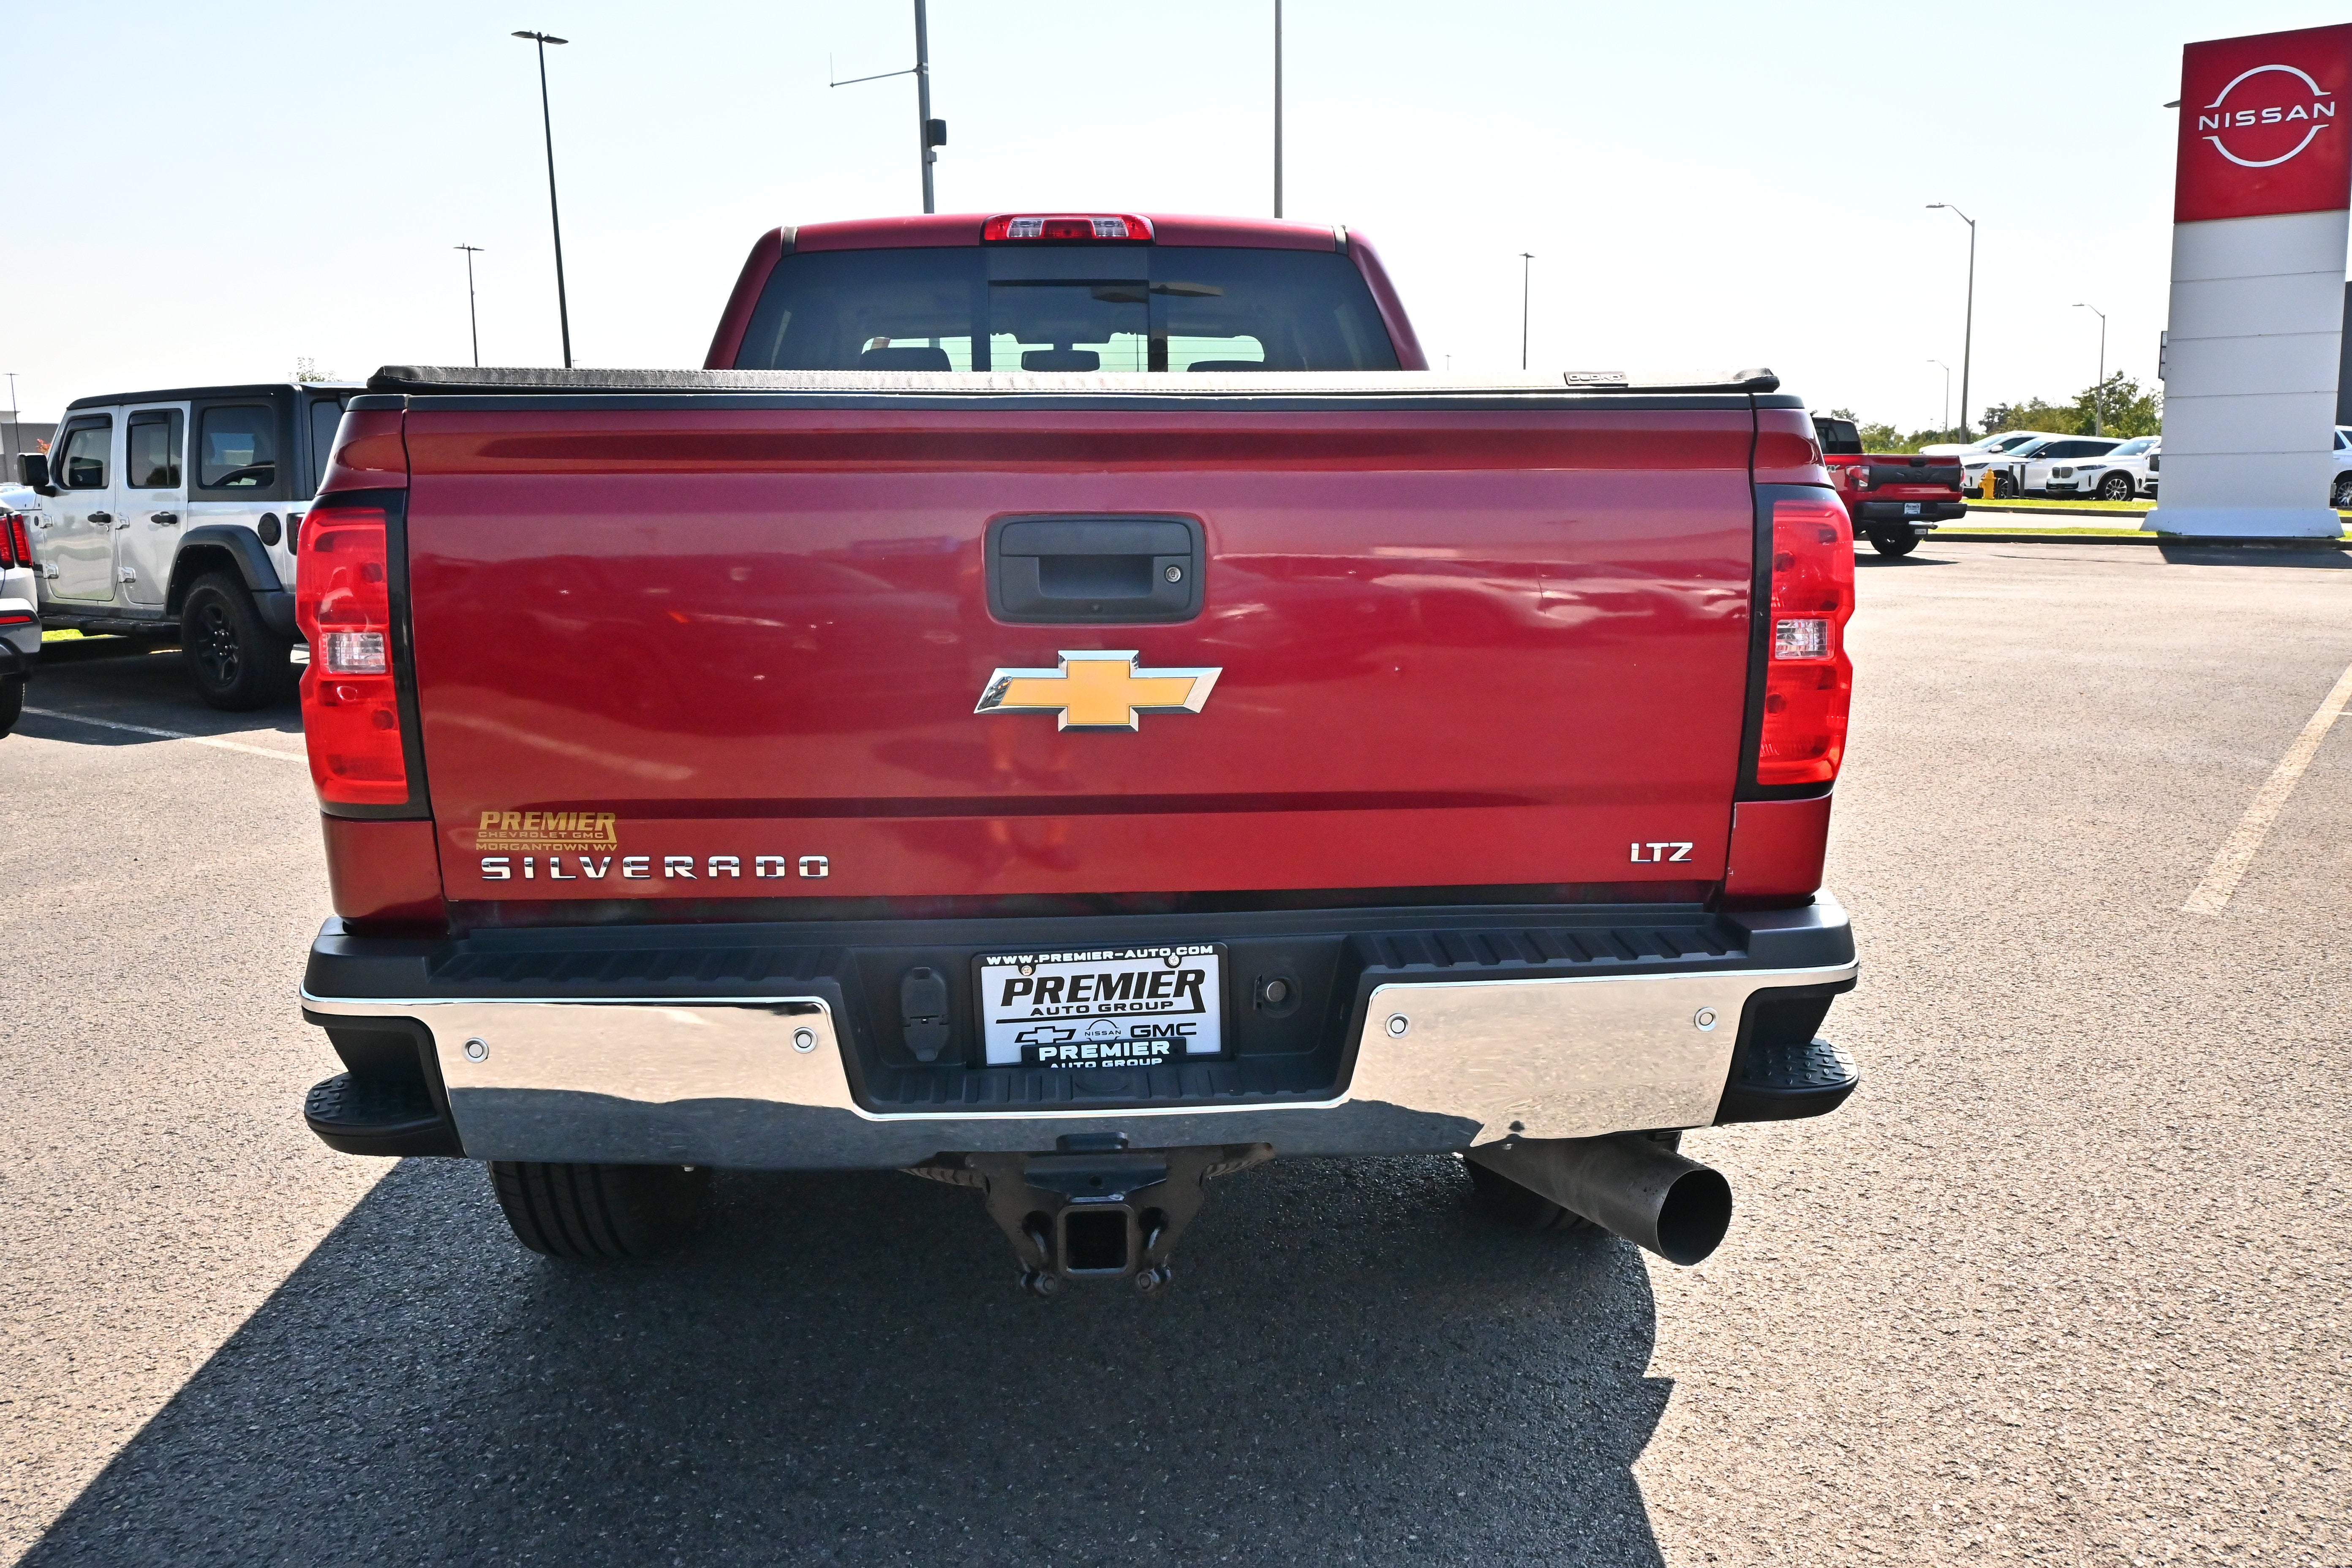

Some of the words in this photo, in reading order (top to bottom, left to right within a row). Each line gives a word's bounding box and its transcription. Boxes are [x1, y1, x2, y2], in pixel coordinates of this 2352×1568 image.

[2199, 101, 2335, 131] NISSAN
[479, 811, 618, 843] PREMIER
[476, 843, 588, 851] MORGANTOWN
[1631, 842, 1693, 863] LTZ
[481, 855, 830, 879] SILVERADO
[986, 945, 1213, 965] WWW.PREMIER-AUTO.COM
[1001, 969, 1206, 1013] PREMIER
[1030, 1004, 1090, 1016] AUTO
[1098, 1001, 1173, 1012] GROUP
[1130, 1022, 1197, 1038] GMC
[1039, 1041, 1170, 1061] PREMIER
[1102, 1058, 1162, 1067] GROUP
